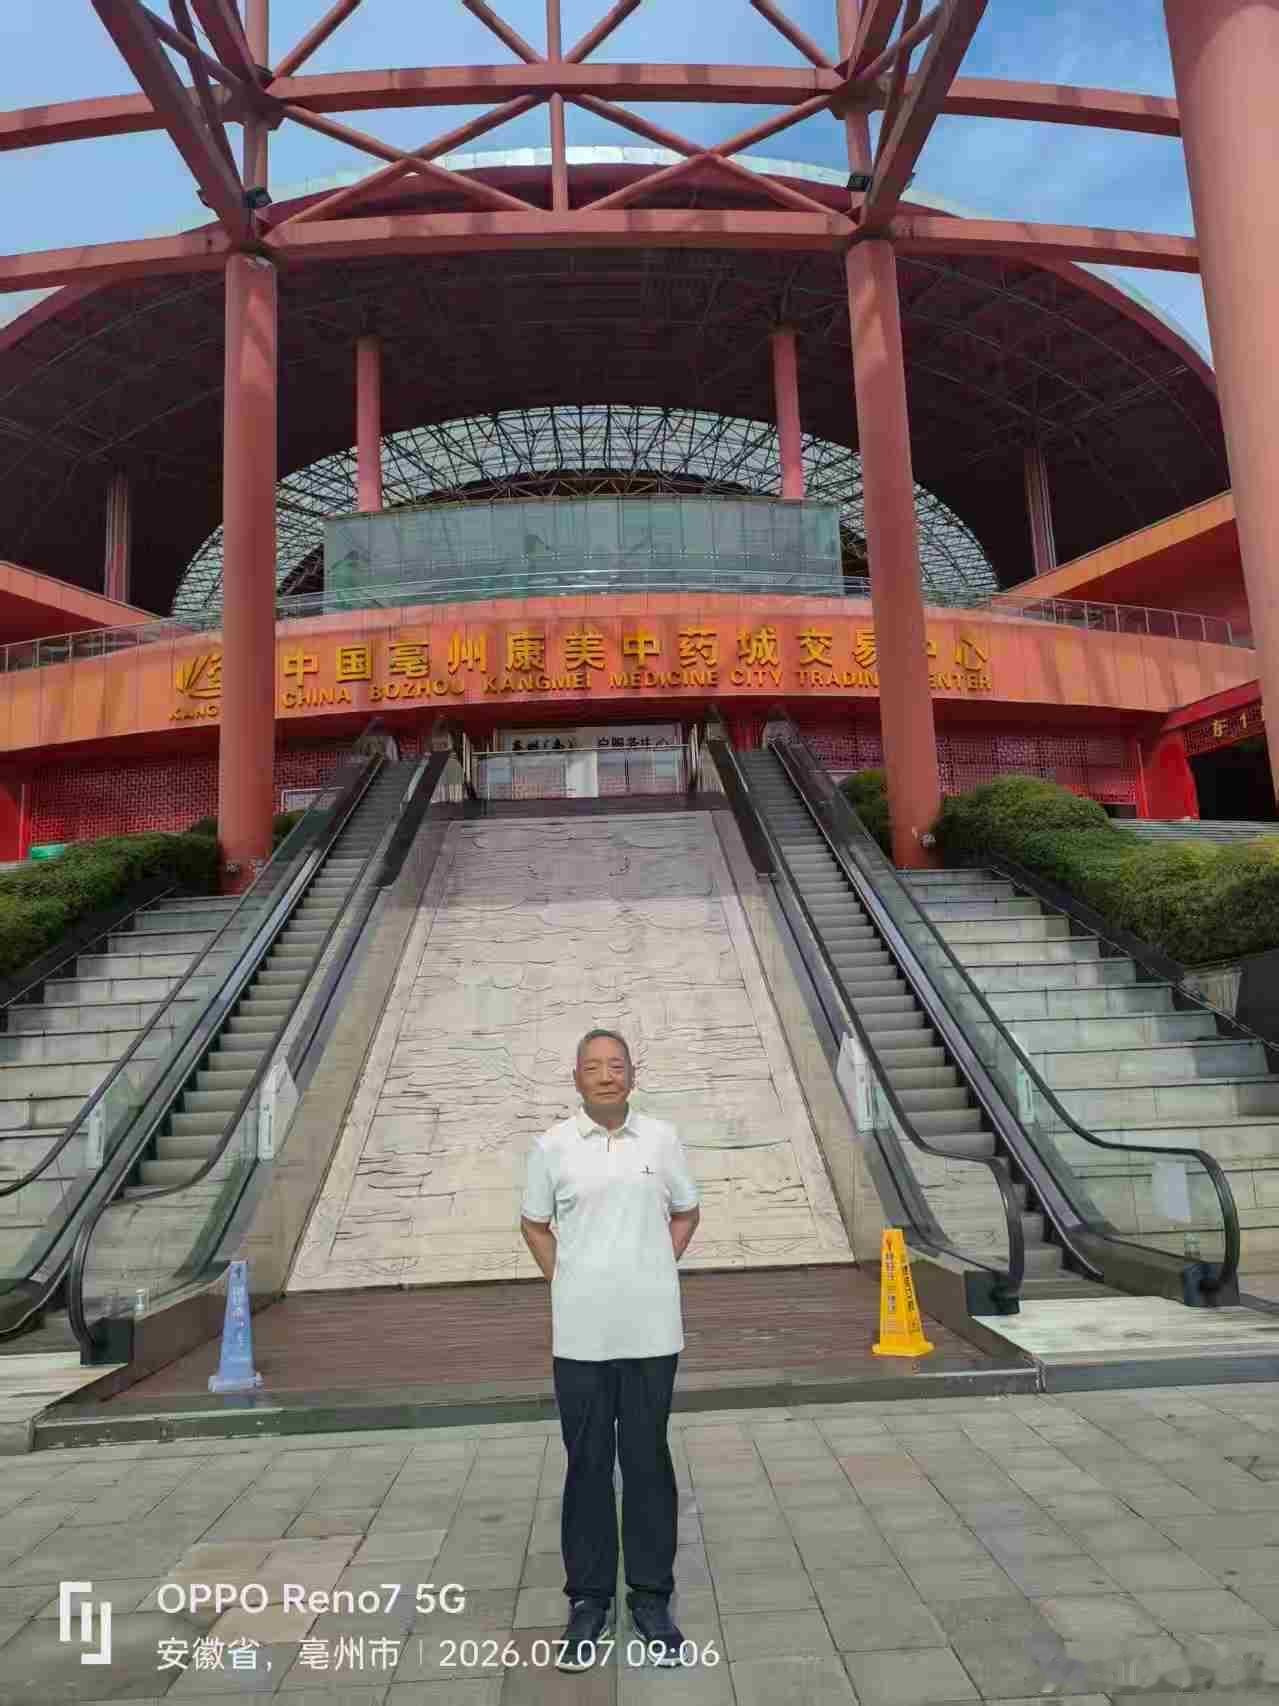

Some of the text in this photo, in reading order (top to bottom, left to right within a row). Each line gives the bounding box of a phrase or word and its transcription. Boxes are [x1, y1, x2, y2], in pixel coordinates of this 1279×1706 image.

[284, 625, 988, 688] 中国亳州康美中药城交易心
[281, 669, 994, 708] CHINA BOZHOU KANGMEI MEDICINE CITY TRADIN ENTER
